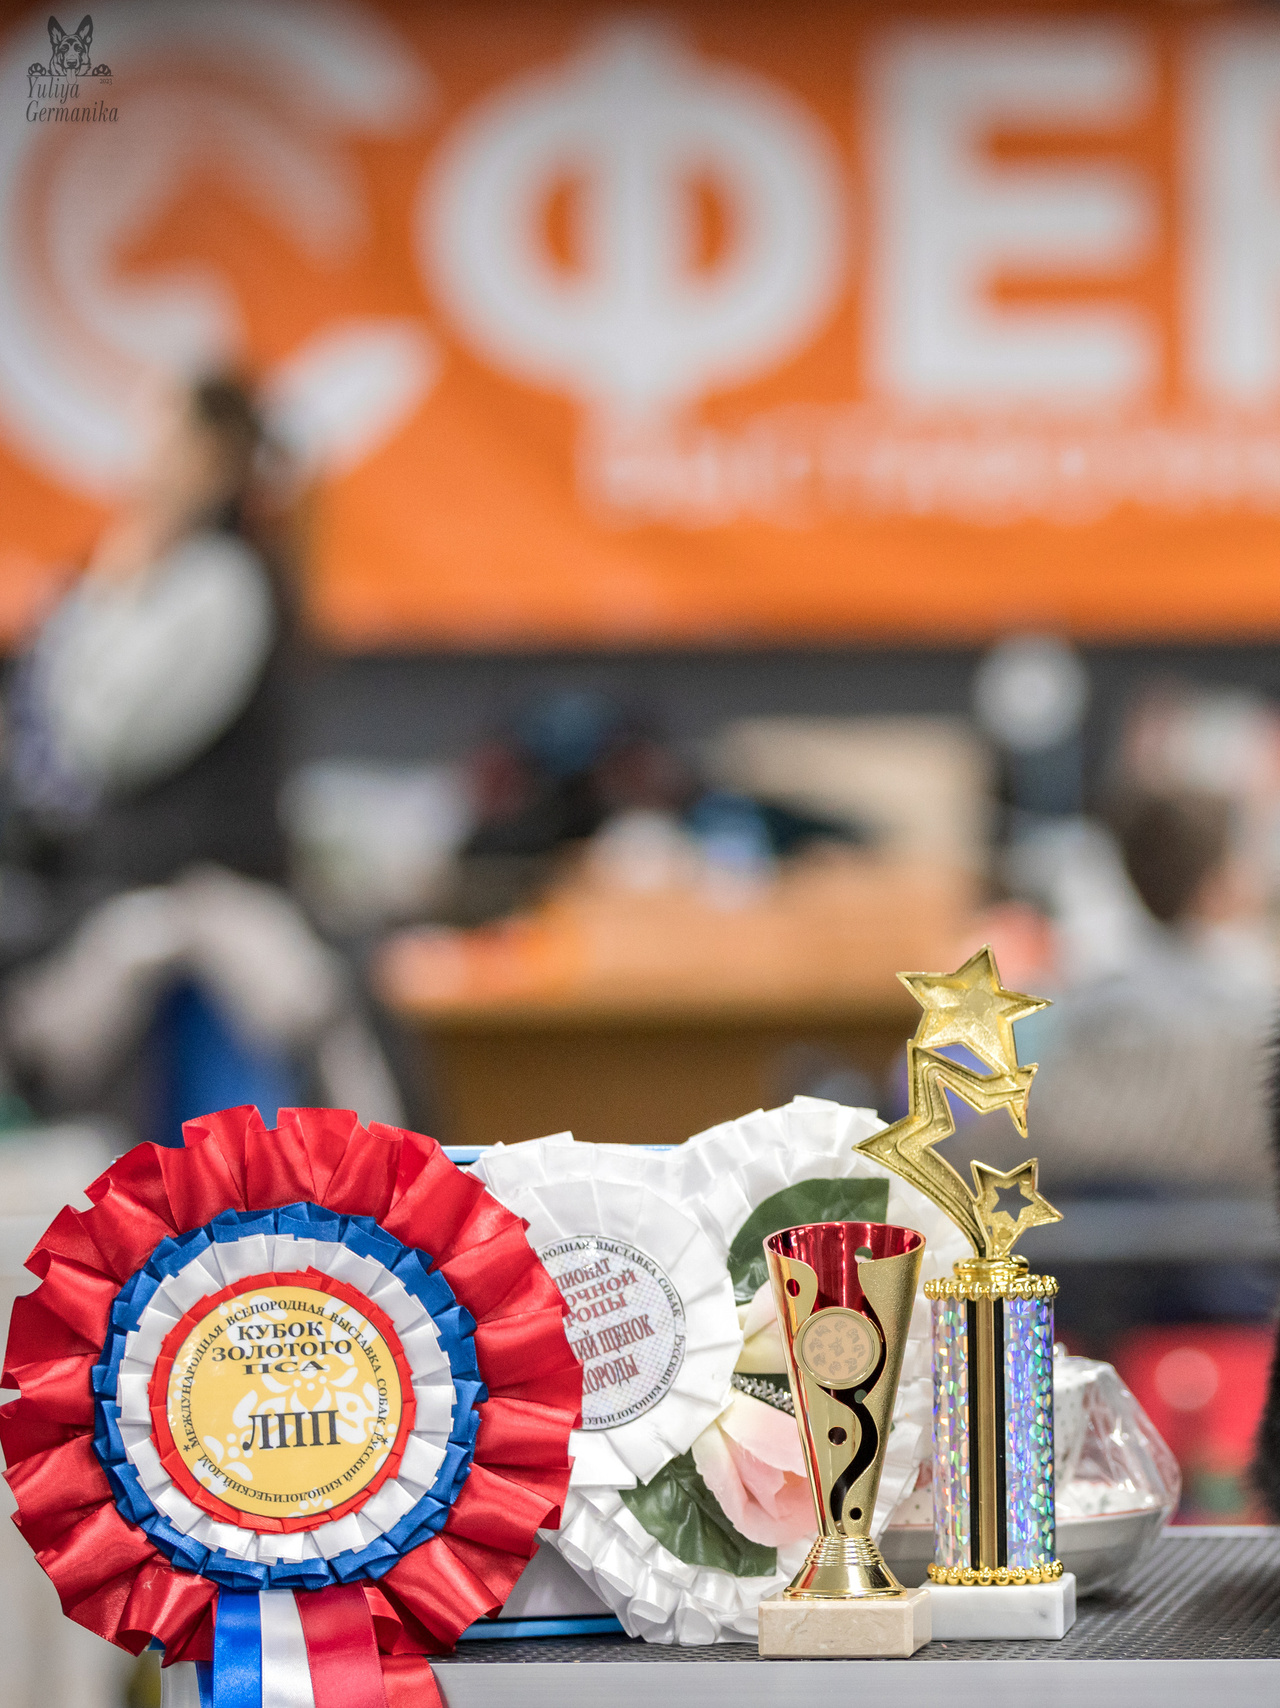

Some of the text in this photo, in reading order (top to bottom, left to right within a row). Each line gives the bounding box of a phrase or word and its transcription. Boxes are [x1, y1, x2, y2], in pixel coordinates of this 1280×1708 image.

[540, 1240, 683, 1318] РОДНАЯ ВЫСТАВКА СОБАК
[552, 1258, 613, 1290] ПИОНАТ
[563, 1267, 639, 1309] ОЧНОЙ
[563, 1292, 628, 1330] РОПЫ
[237, 1320, 324, 1341] КУБОК
[596, 1312, 656, 1355] ЩЕНОК
[211, 1339, 353, 1362] ЗОЛОТОГО
[242, 1360, 328, 1375] ПСА
[181, 1299, 390, 1449] МЕЖДУНАРОДНАЯ ВСЕПОРОДНАЯ ВЫСТАВКА СОБАК
[583, 1383, 664, 1426] КИНОЛОГИЧЕС
[242, 1409, 342, 1451] ЛПП
[197, 1453, 223, 1480] ДОМ
[222, 1474, 344, 1503] КИНОЛОГИЧЕСКИЙ
